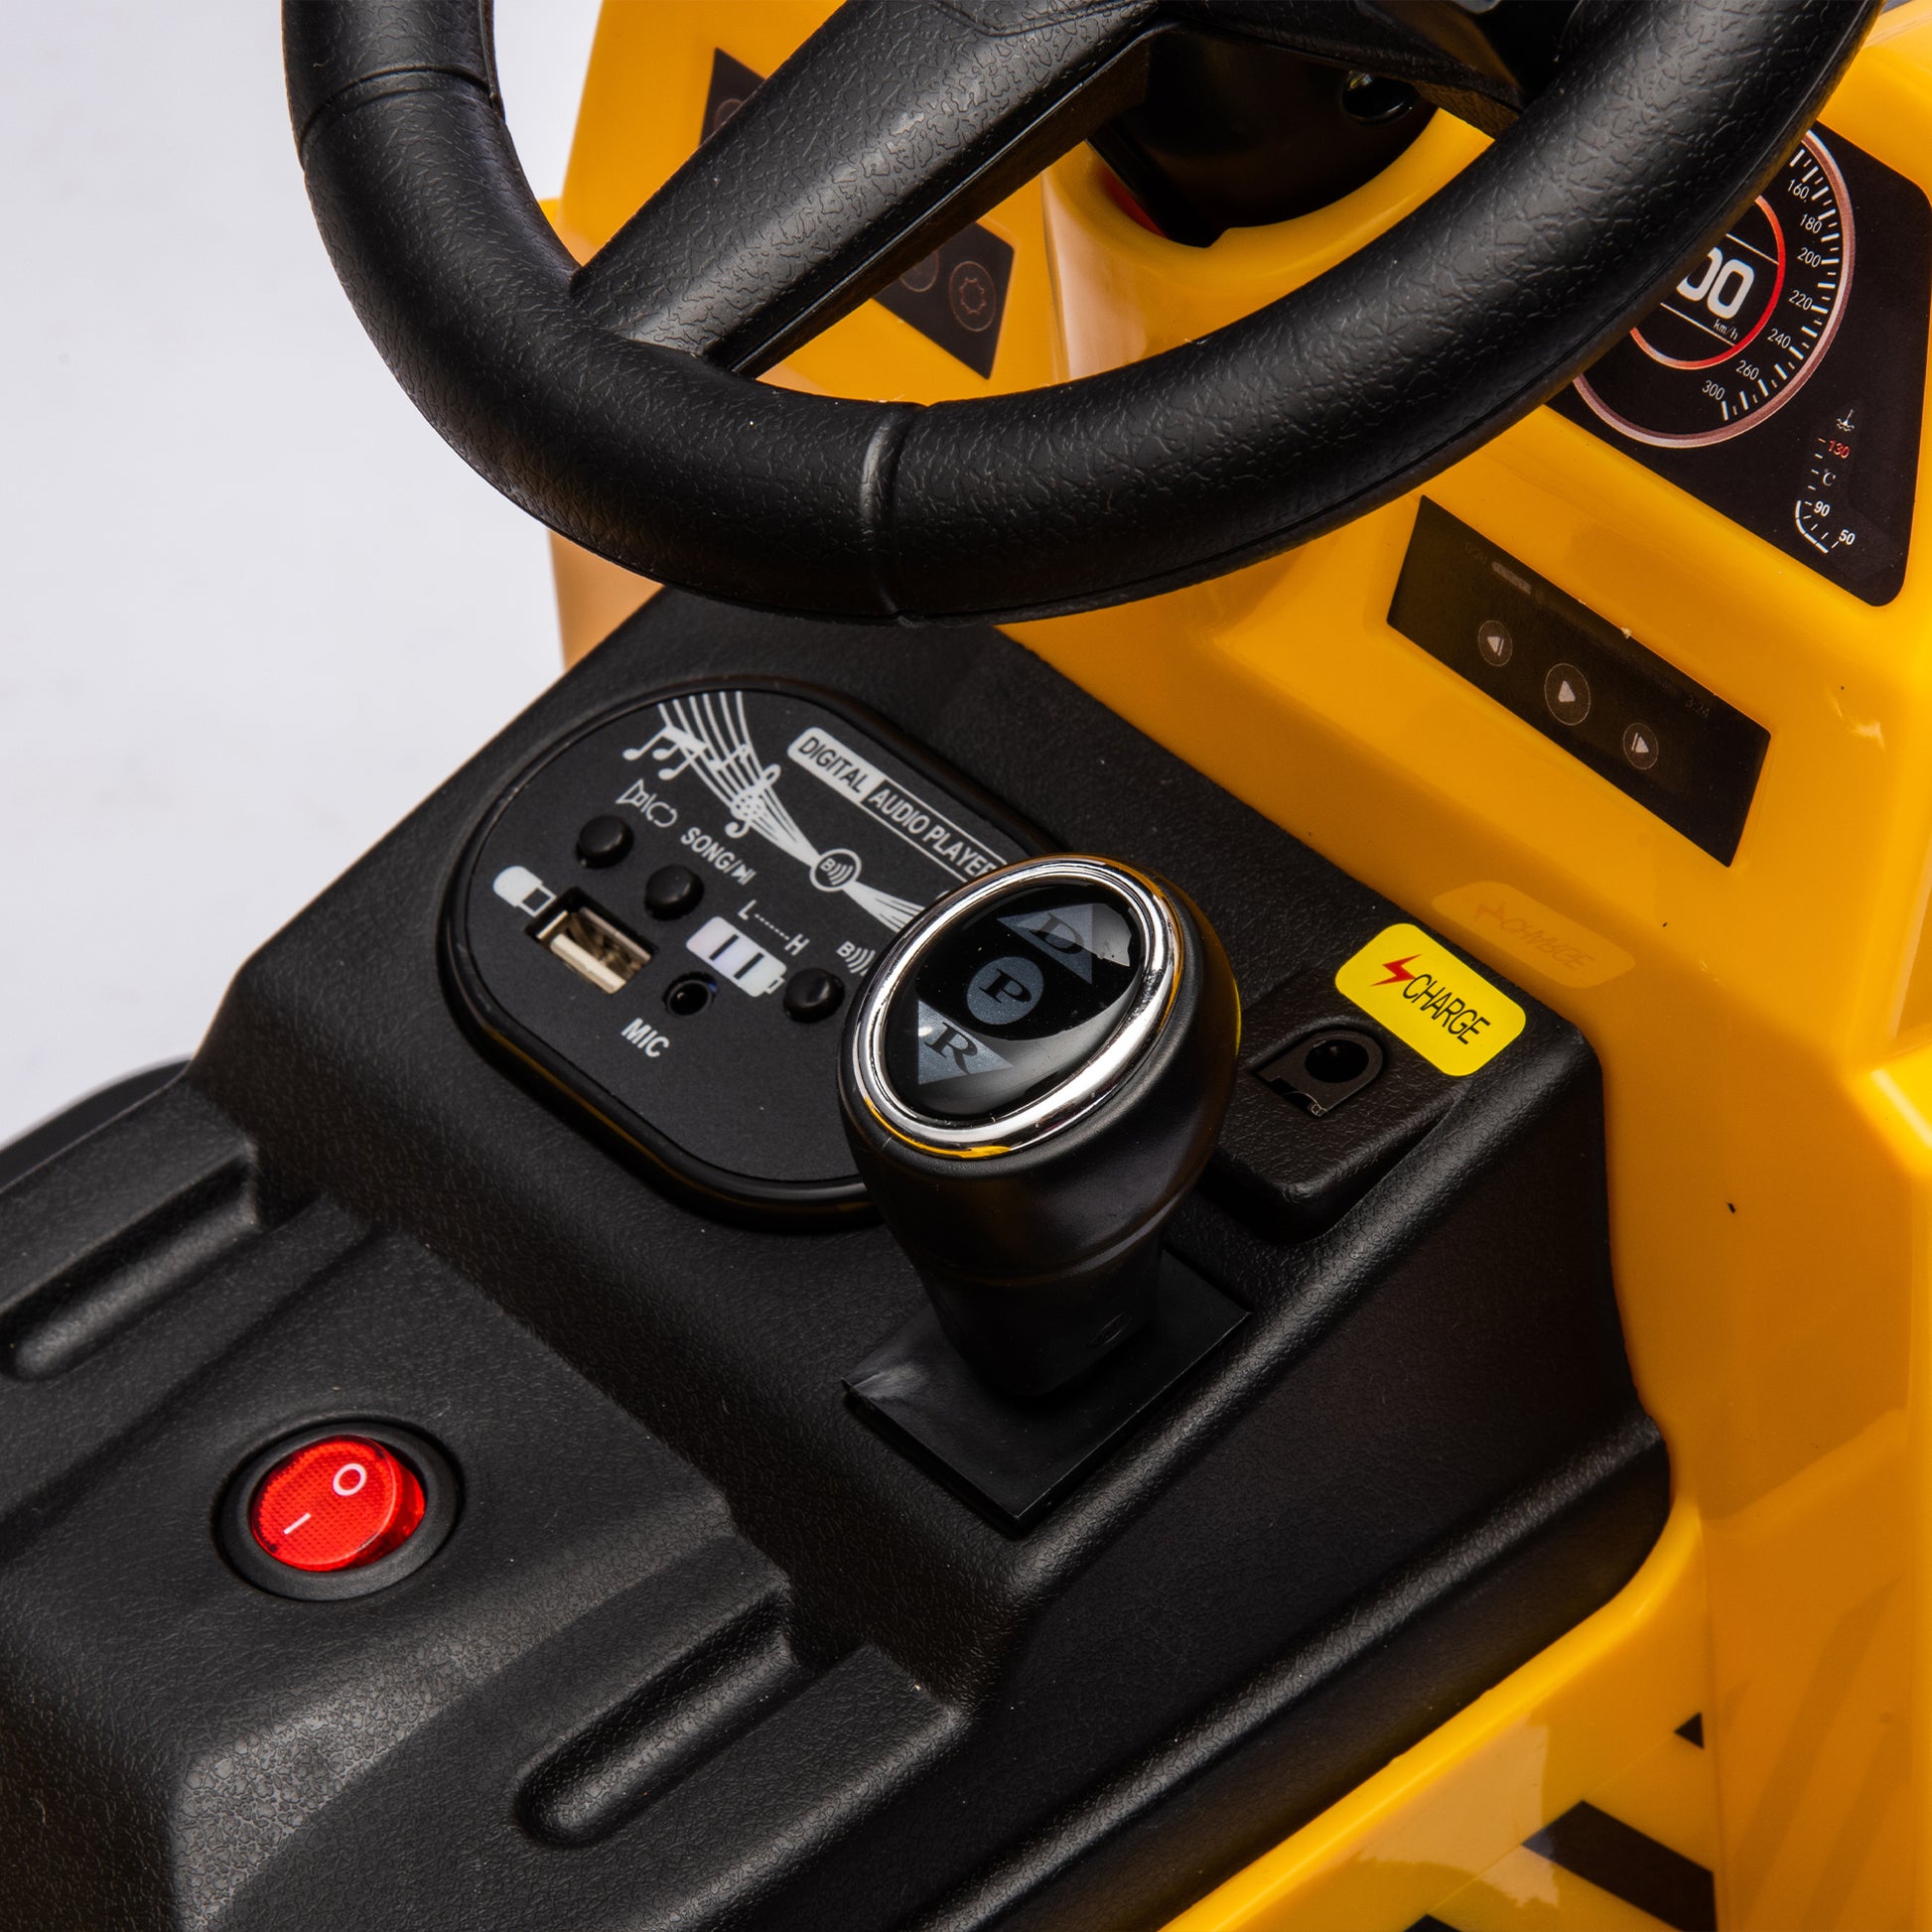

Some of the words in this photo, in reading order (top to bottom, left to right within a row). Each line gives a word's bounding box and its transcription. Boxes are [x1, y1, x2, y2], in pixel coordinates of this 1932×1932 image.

[1787, 179, 1810, 199] 160
[1800, 213, 1823, 234] 180
[1796, 247, 1822, 268] 200
[1788, 289, 1813, 311] 220
[1713, 318, 1738, 341] km/h
[1767, 328, 1791, 348] 240
[1735, 359, 1760, 380] 260
[1702, 379, 1725, 400] 300
[1827, 440, 1851, 459] 130
[1814, 500, 1831, 517] 90
[1839, 528, 1856, 545] 50
[797, 737, 869, 793] DIGITAL
[868, 788, 931, 834] AUDIO
[1029, 912, 1087, 956] D
[978, 967, 1034, 1005] P
[1402, 973, 1491, 1045] CHARGE
[621, 1018, 670, 1058] MIC
[924, 1022, 979, 1075] R
